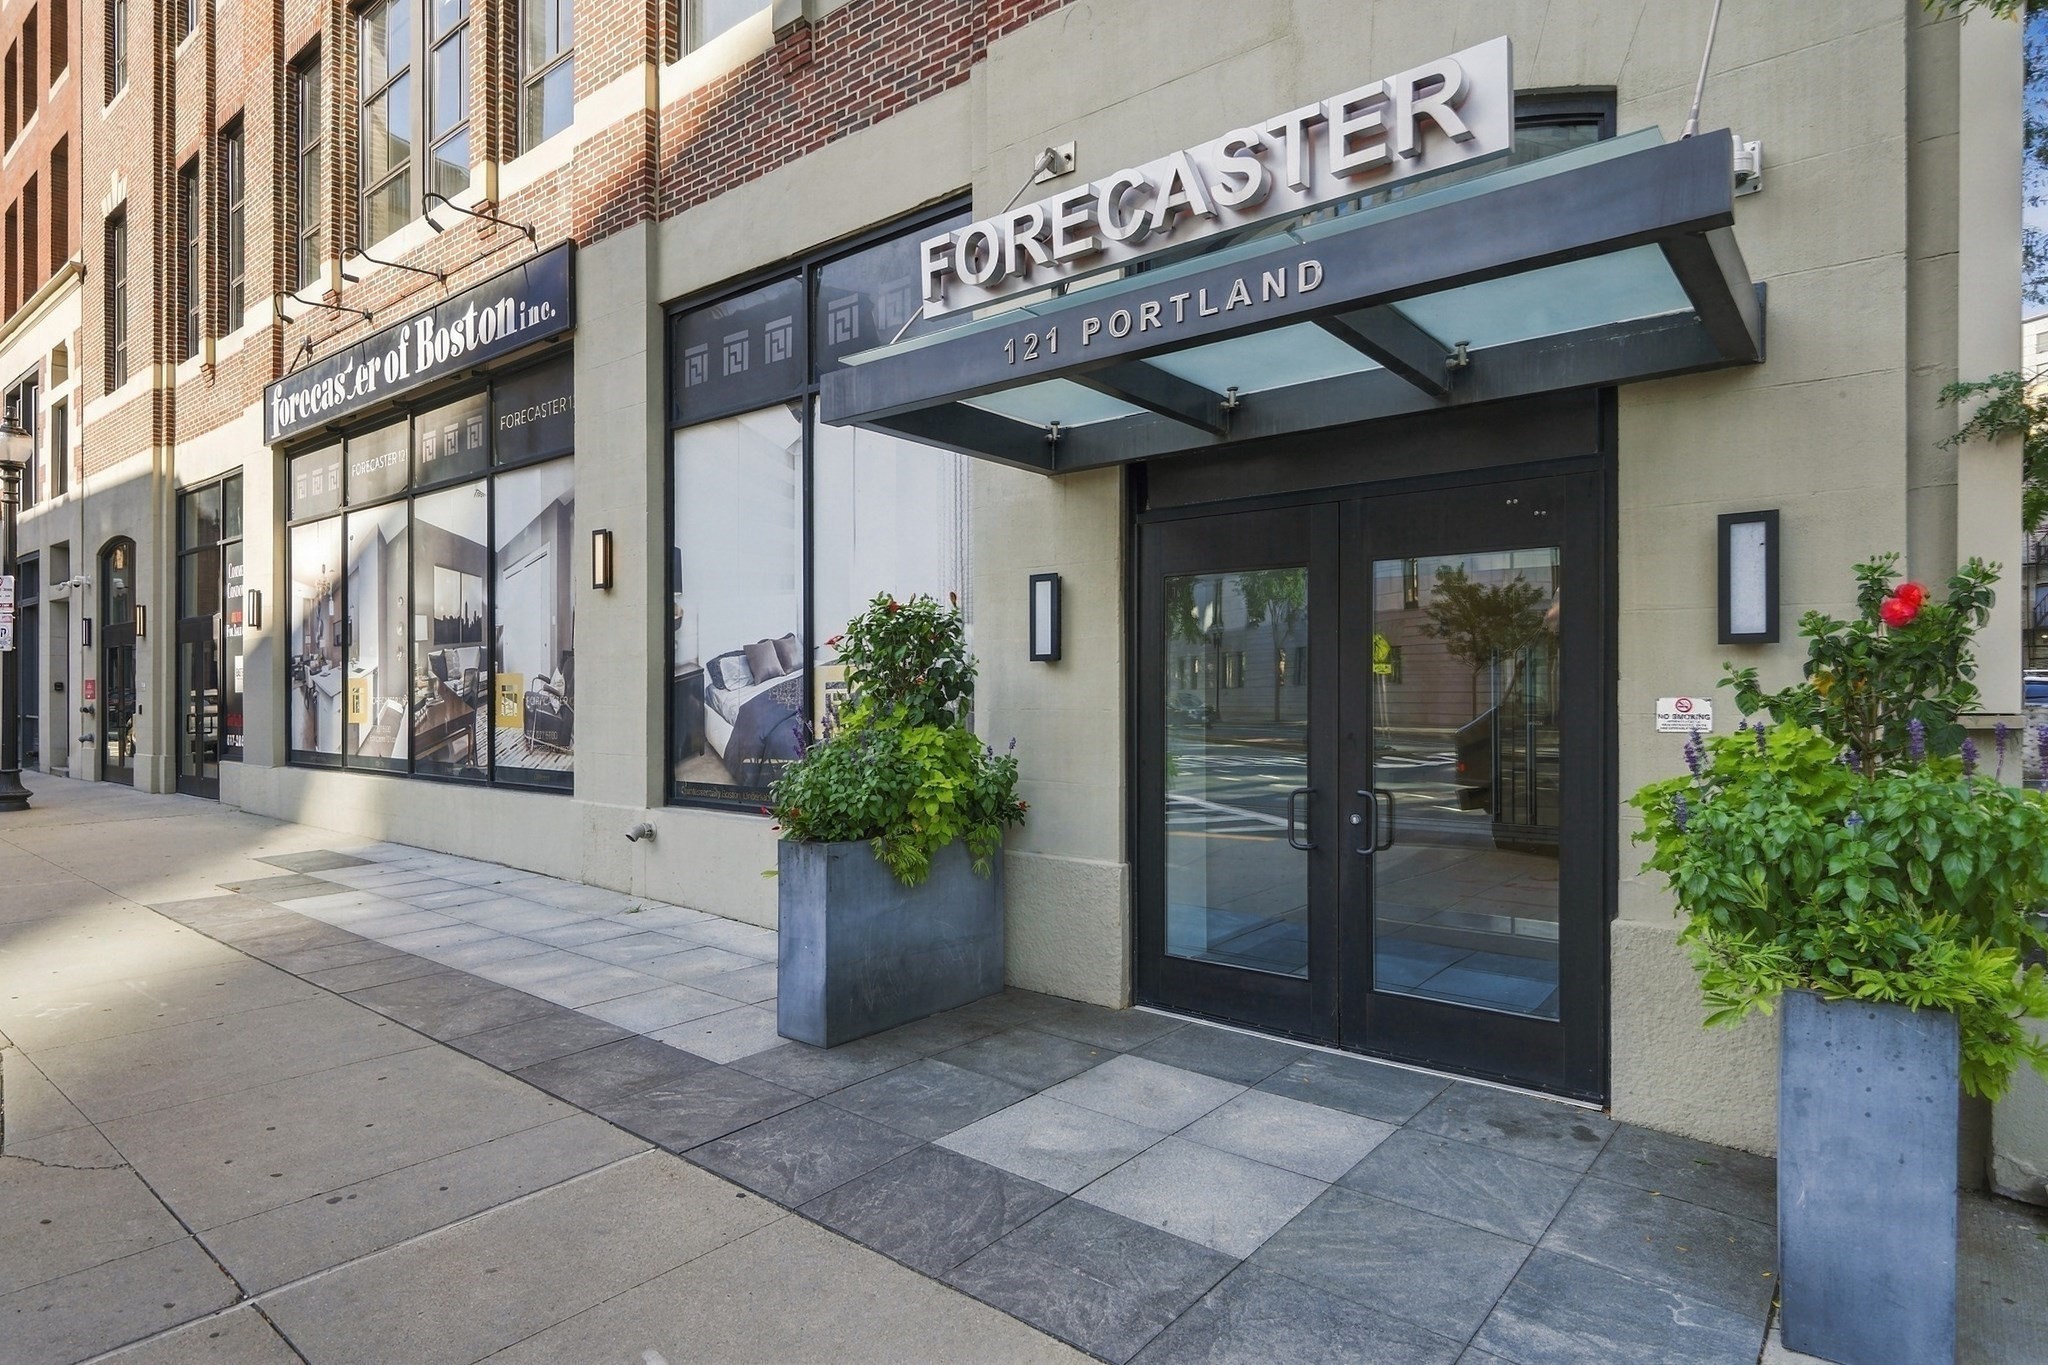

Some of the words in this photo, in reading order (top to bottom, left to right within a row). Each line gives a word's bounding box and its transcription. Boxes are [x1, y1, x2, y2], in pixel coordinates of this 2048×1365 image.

[920, 57, 1474, 303] FORECASTER
[1003, 327, 1057, 365] 121
[1082, 259, 1324, 347] PORTLAND
[271, 358, 381, 439] forecaster
[384, 326, 410, 384] of
[414, 296, 517, 374] Boston
[519, 301, 556, 331] inc.
[500, 396, 567, 431] FORECASTER
[351, 451, 398, 477] FORECASTER
